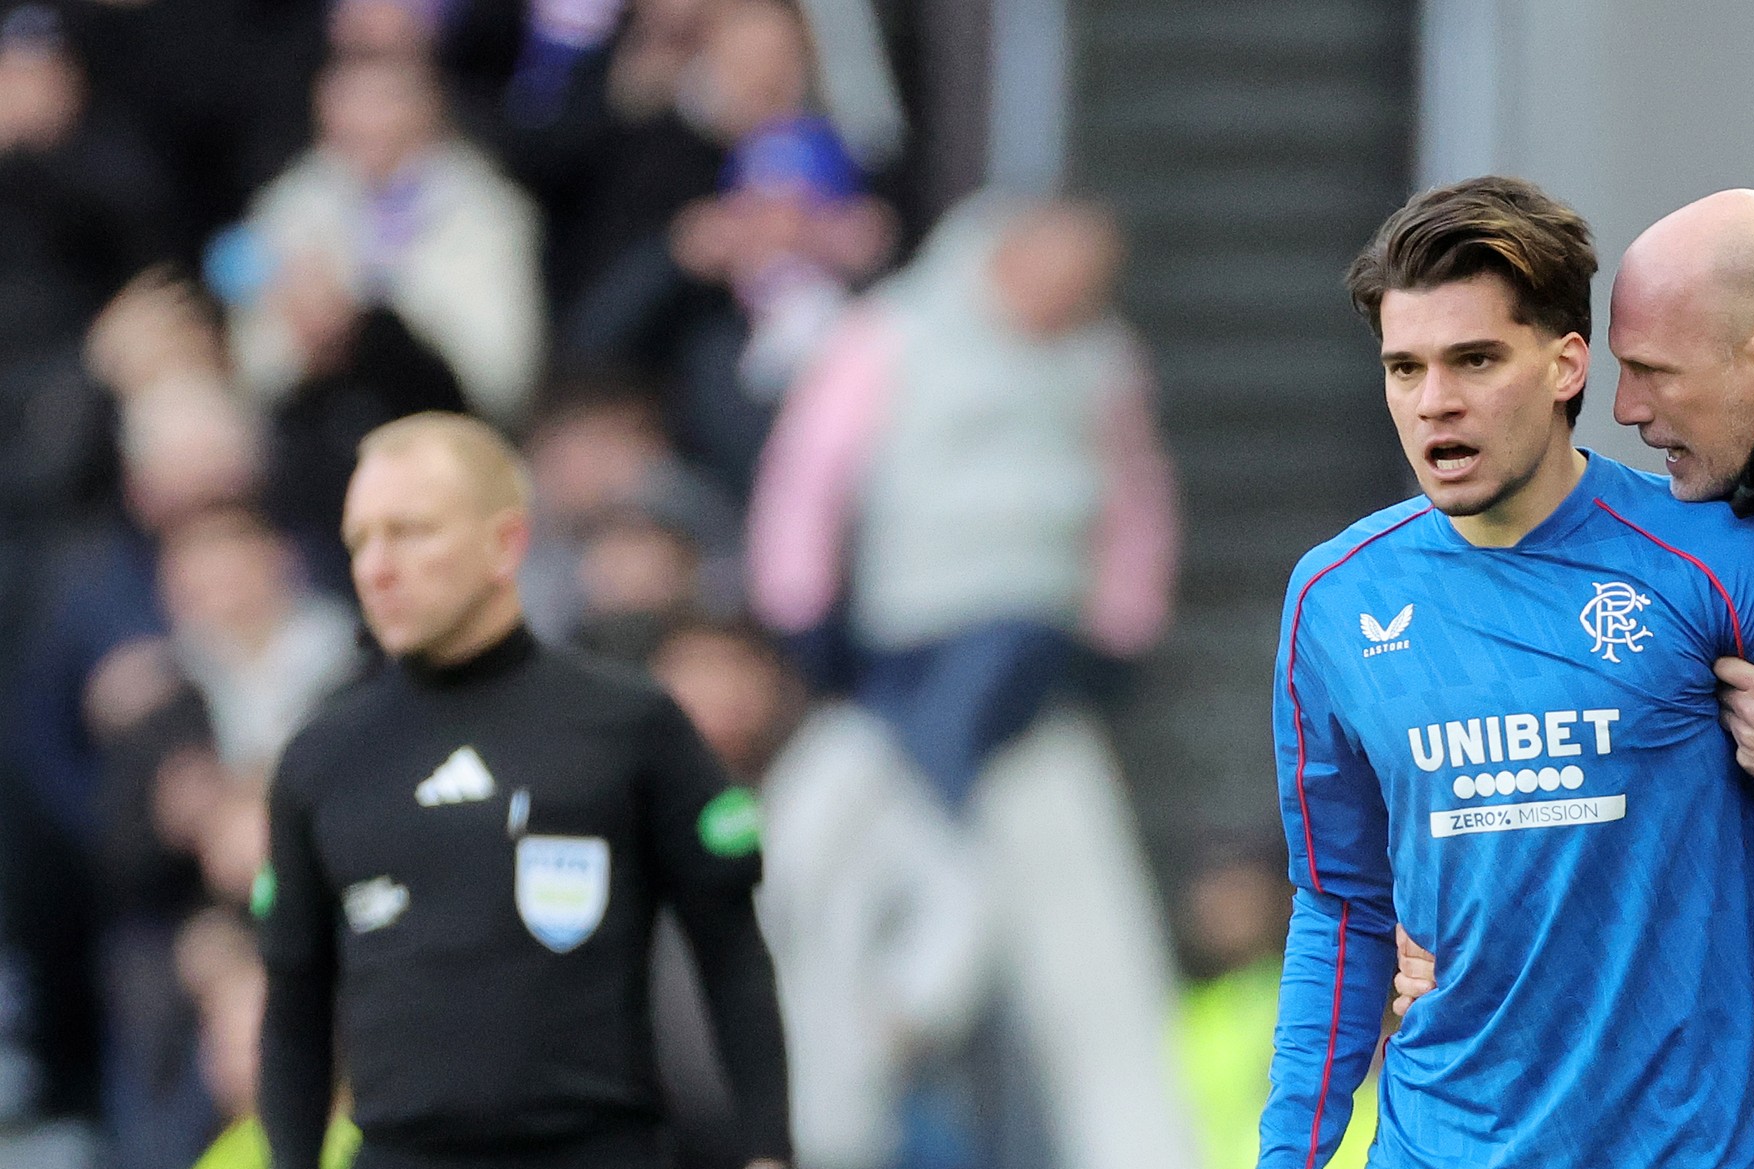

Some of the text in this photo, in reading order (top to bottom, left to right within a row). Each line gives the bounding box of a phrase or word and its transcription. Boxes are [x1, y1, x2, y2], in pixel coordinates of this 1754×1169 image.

[1363, 639, 1411, 658] CASTORE
[1407, 708, 1621, 773] UNIBET
[1450, 802, 1600, 831] ZERO% MISSION
